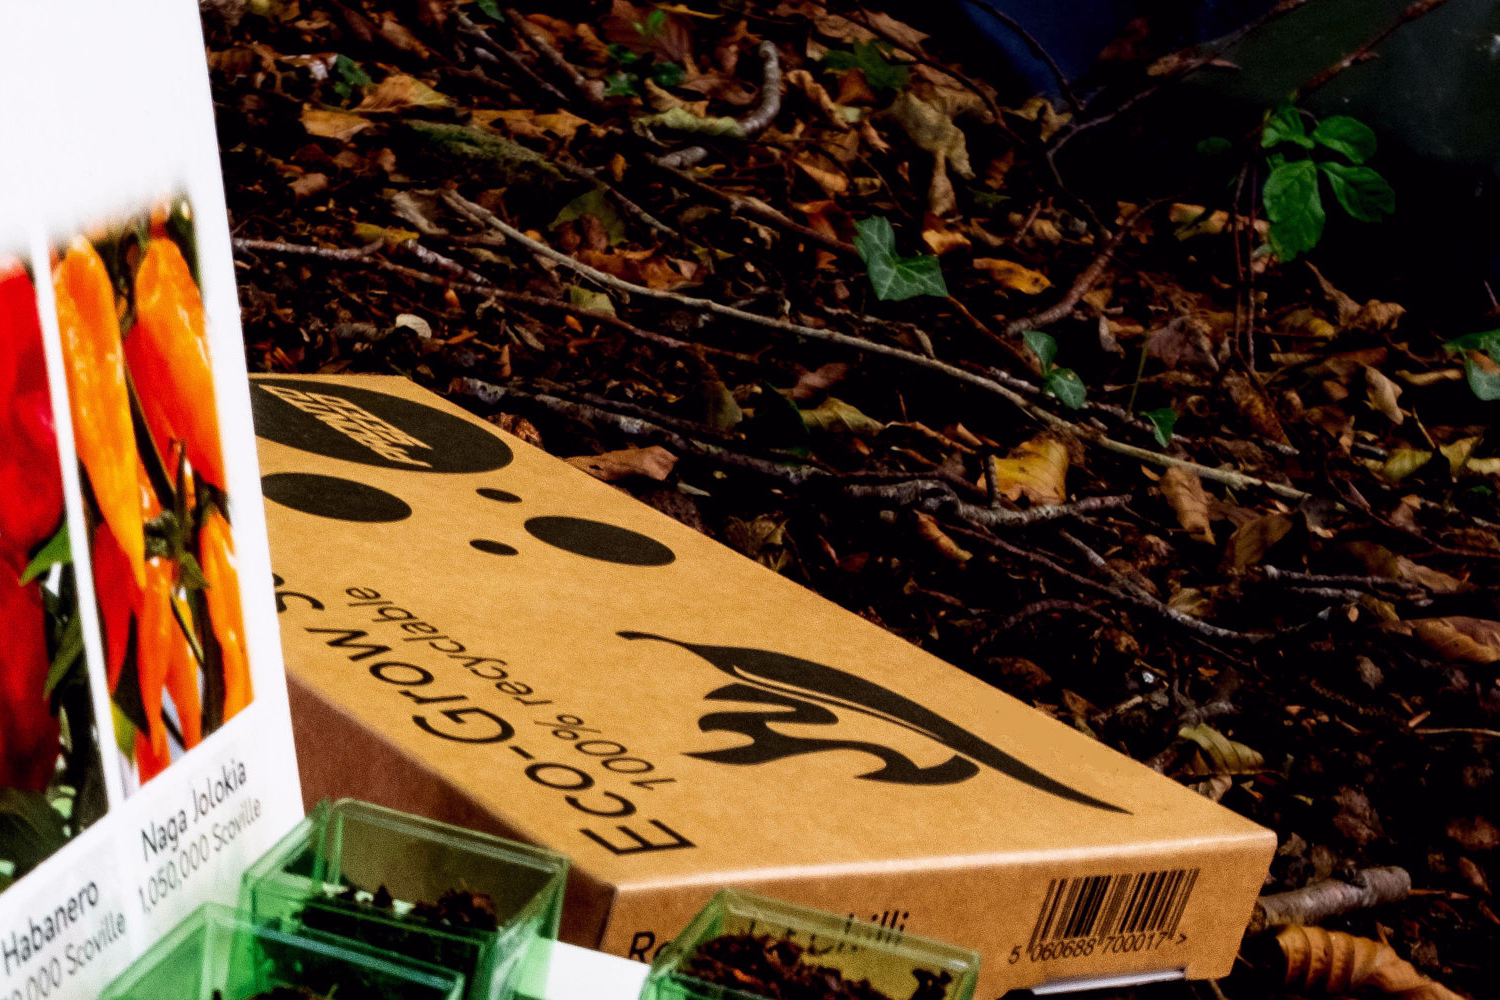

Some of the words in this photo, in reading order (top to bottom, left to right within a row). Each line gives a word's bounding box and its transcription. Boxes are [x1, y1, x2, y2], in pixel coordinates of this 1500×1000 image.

[345, 585, 553, 707] recyclable
[305, 626, 697, 856] Eco-Grow
[533, 713, 678, 791] 100%
[138, 834, 211, 914] 1,050,000
[211, 797, 263, 853] Scoville
[140, 808, 189, 863] Naga
[191, 758, 248, 823] Jolokia
[1, 881, 100, 977] Habanero
[64, 911, 127, 977] Scoville
[1008, 945, 1022, 965] 5
[1030, 937, 1097, 963] 060688
[1102, 931, 1169, 955] 700017
